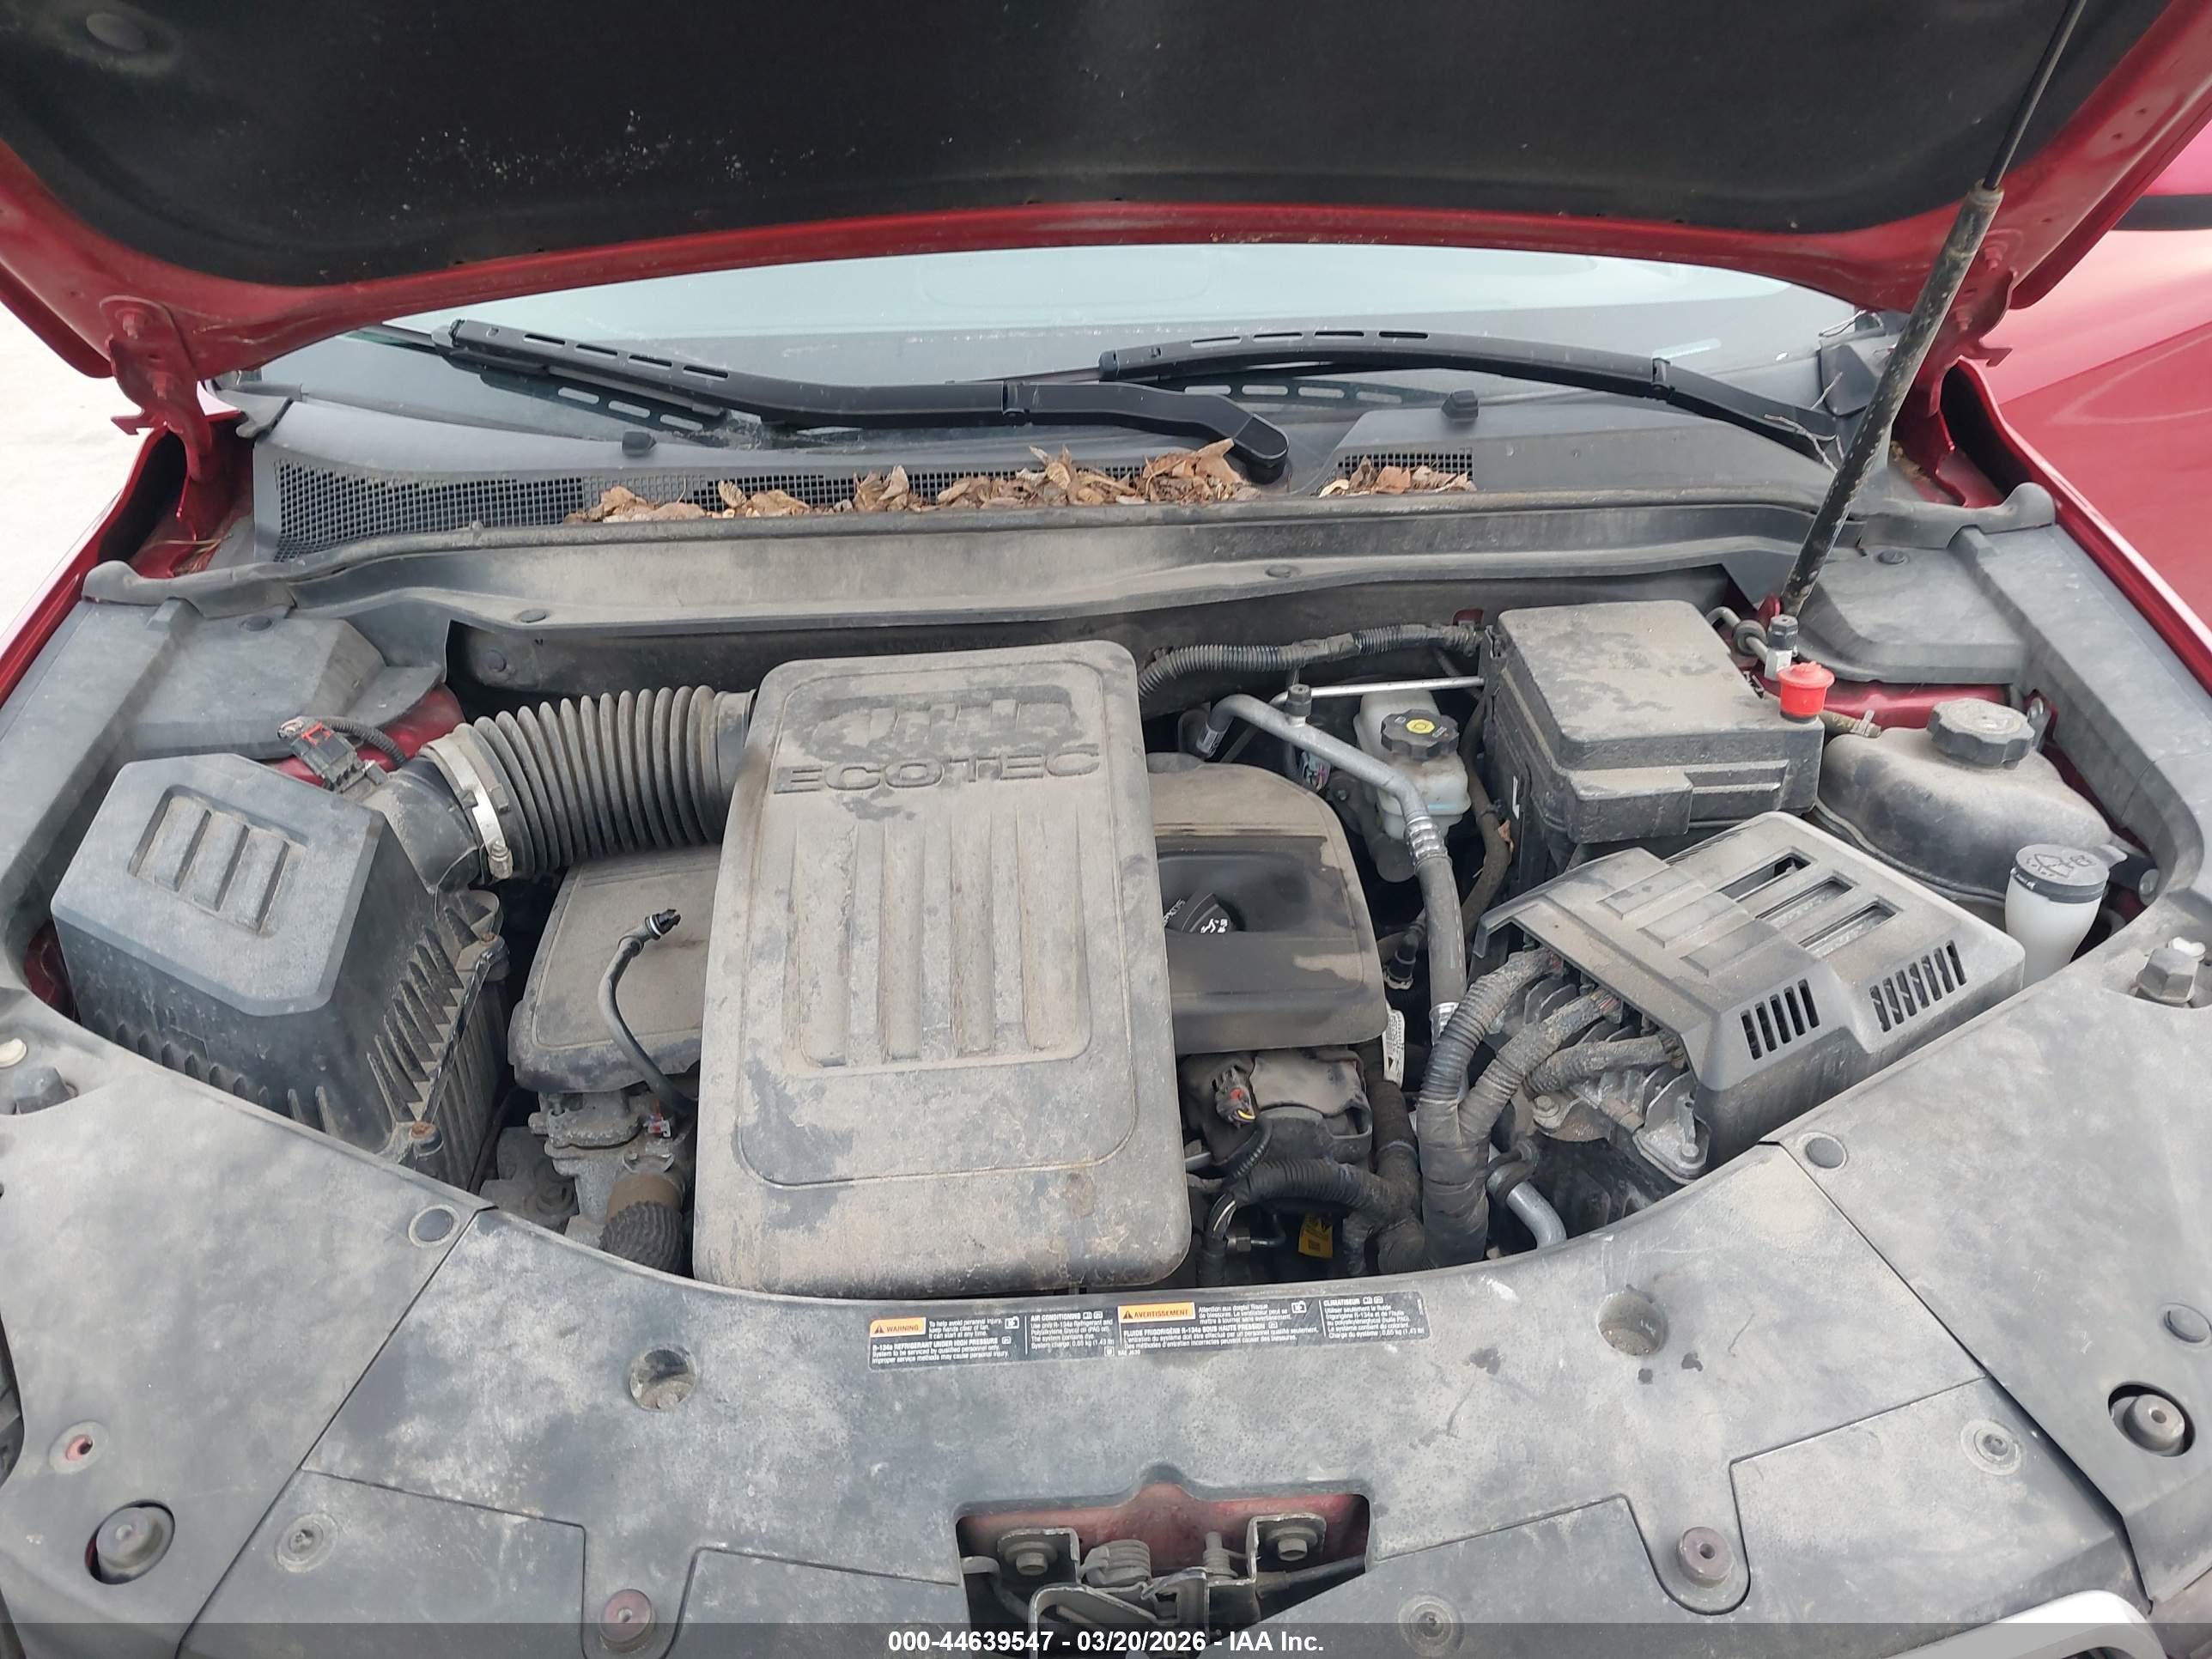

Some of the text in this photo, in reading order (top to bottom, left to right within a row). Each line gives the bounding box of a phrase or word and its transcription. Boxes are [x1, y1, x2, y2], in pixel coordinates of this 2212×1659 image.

[774, 744, 1099, 794] ECOTEC
[1135, 1309, 1188, 1319] AVERTISSEMENT
[887, 1324, 918, 1333] WARNING
